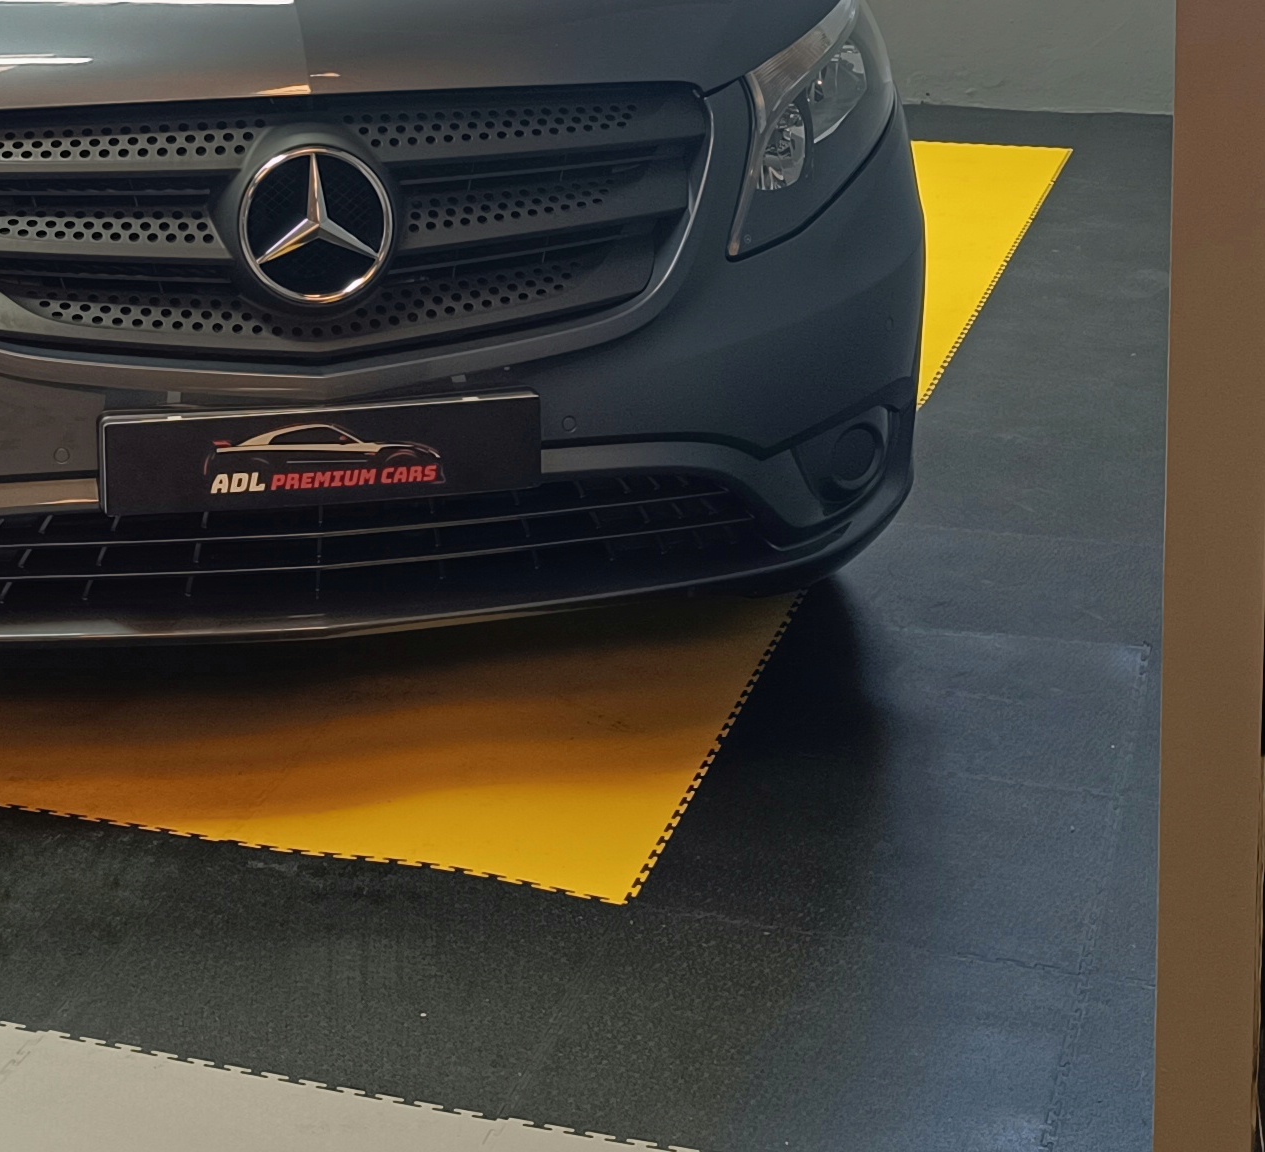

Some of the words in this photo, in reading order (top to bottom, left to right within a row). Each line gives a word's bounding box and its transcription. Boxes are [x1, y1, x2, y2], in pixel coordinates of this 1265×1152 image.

[210, 472, 266, 494] ADL
[270, 468, 377, 491] PREMIUM
[380, 464, 438, 484] CARS
